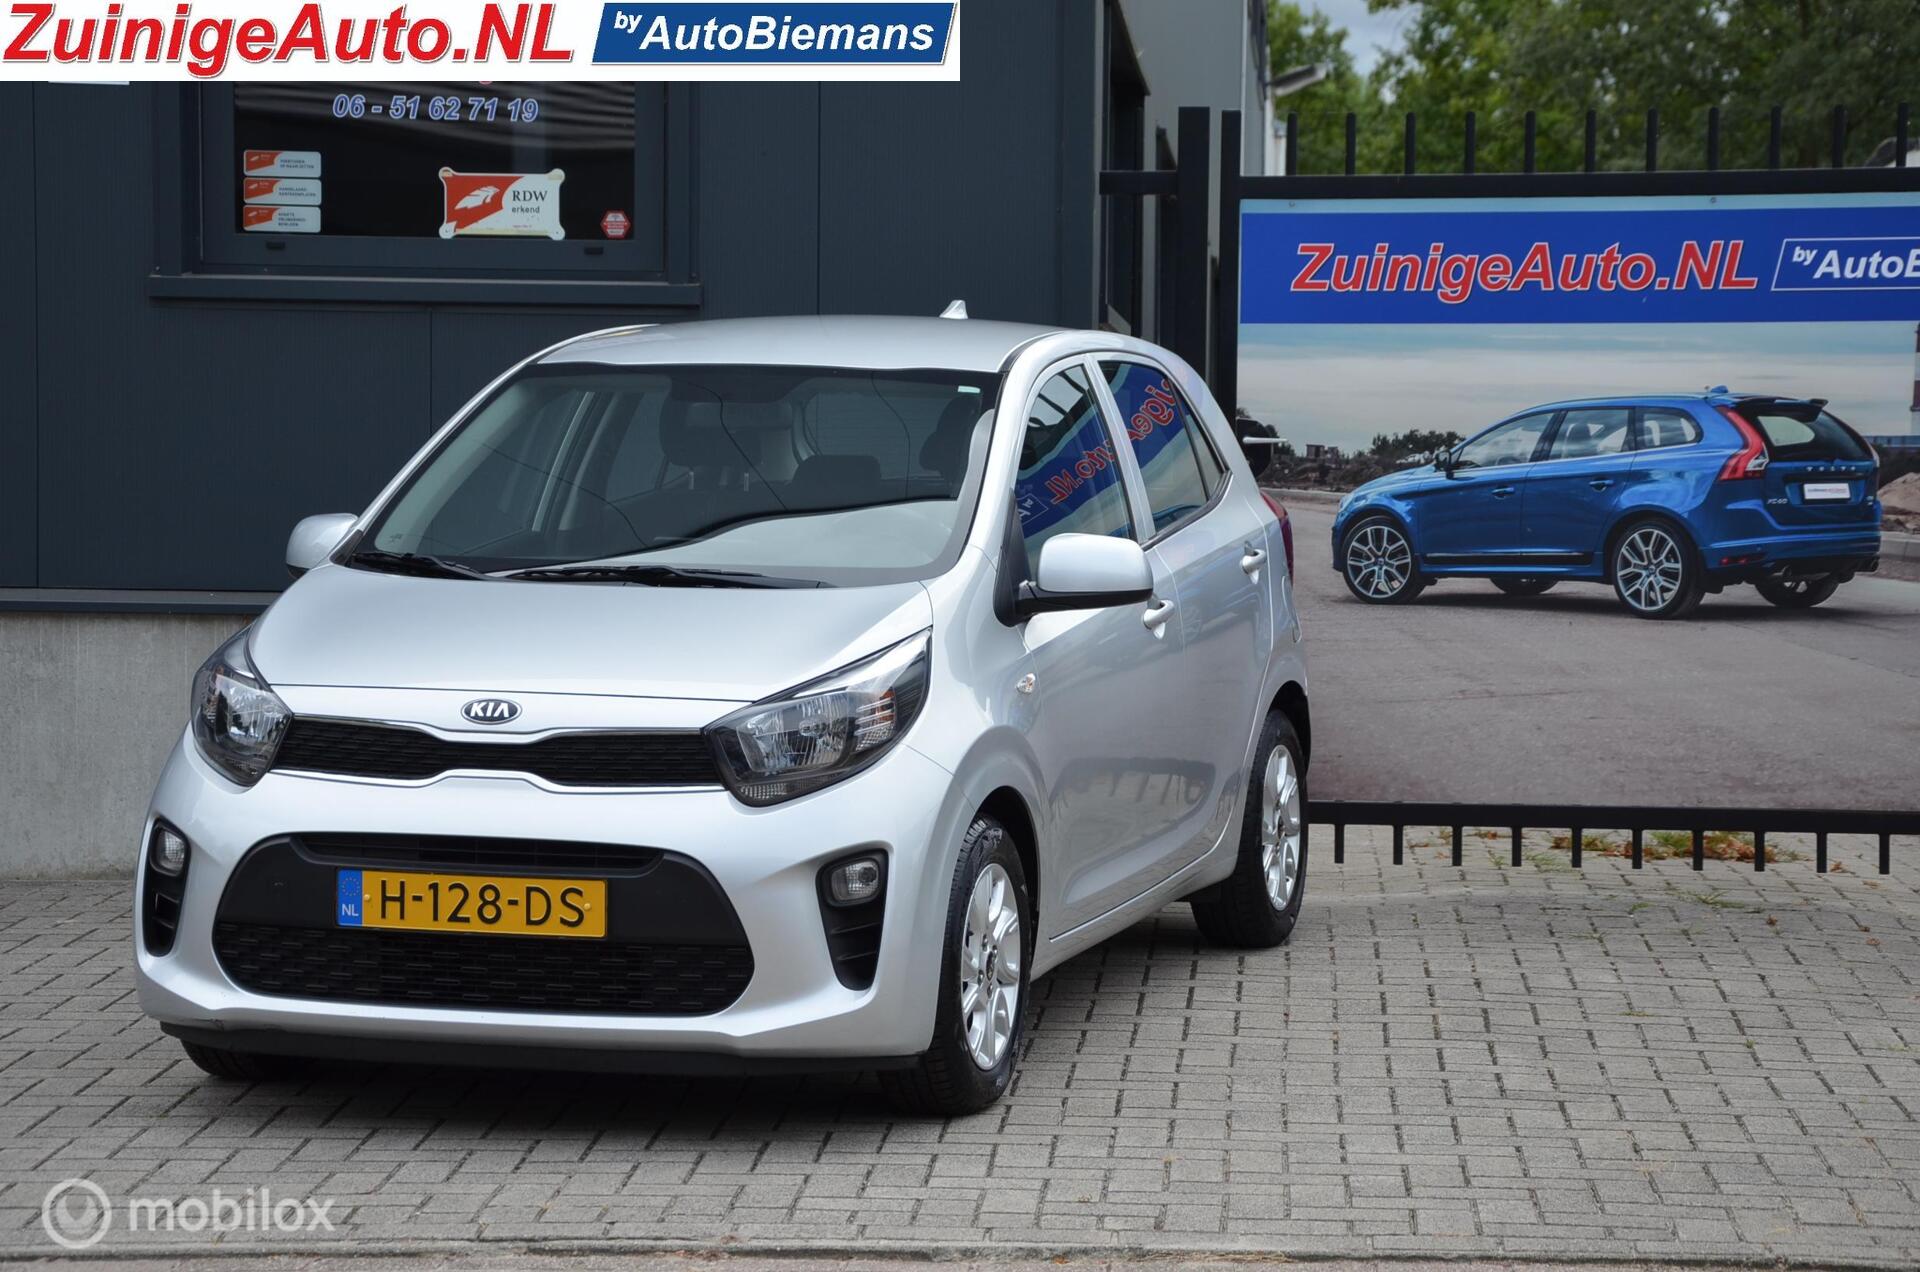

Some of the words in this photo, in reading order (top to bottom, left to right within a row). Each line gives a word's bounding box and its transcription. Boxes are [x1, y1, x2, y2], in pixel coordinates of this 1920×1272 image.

[332, 93, 366, 118] 06
[388, 95, 421, 120] 51
[428, 96, 461, 121] 62
[468, 97, 499, 122] 71
[507, 98, 539, 123] 19
[512, 190, 548, 202] RDW
[511, 205, 540, 214] erkend
[1290, 239, 1759, 304] ZuinigeAuto.NL
[1792, 246, 1818, 266] by
[470, 701, 510, 718] KIA
[341, 904, 359, 917] NL
[380, 879, 585, 928] H-128-DS
